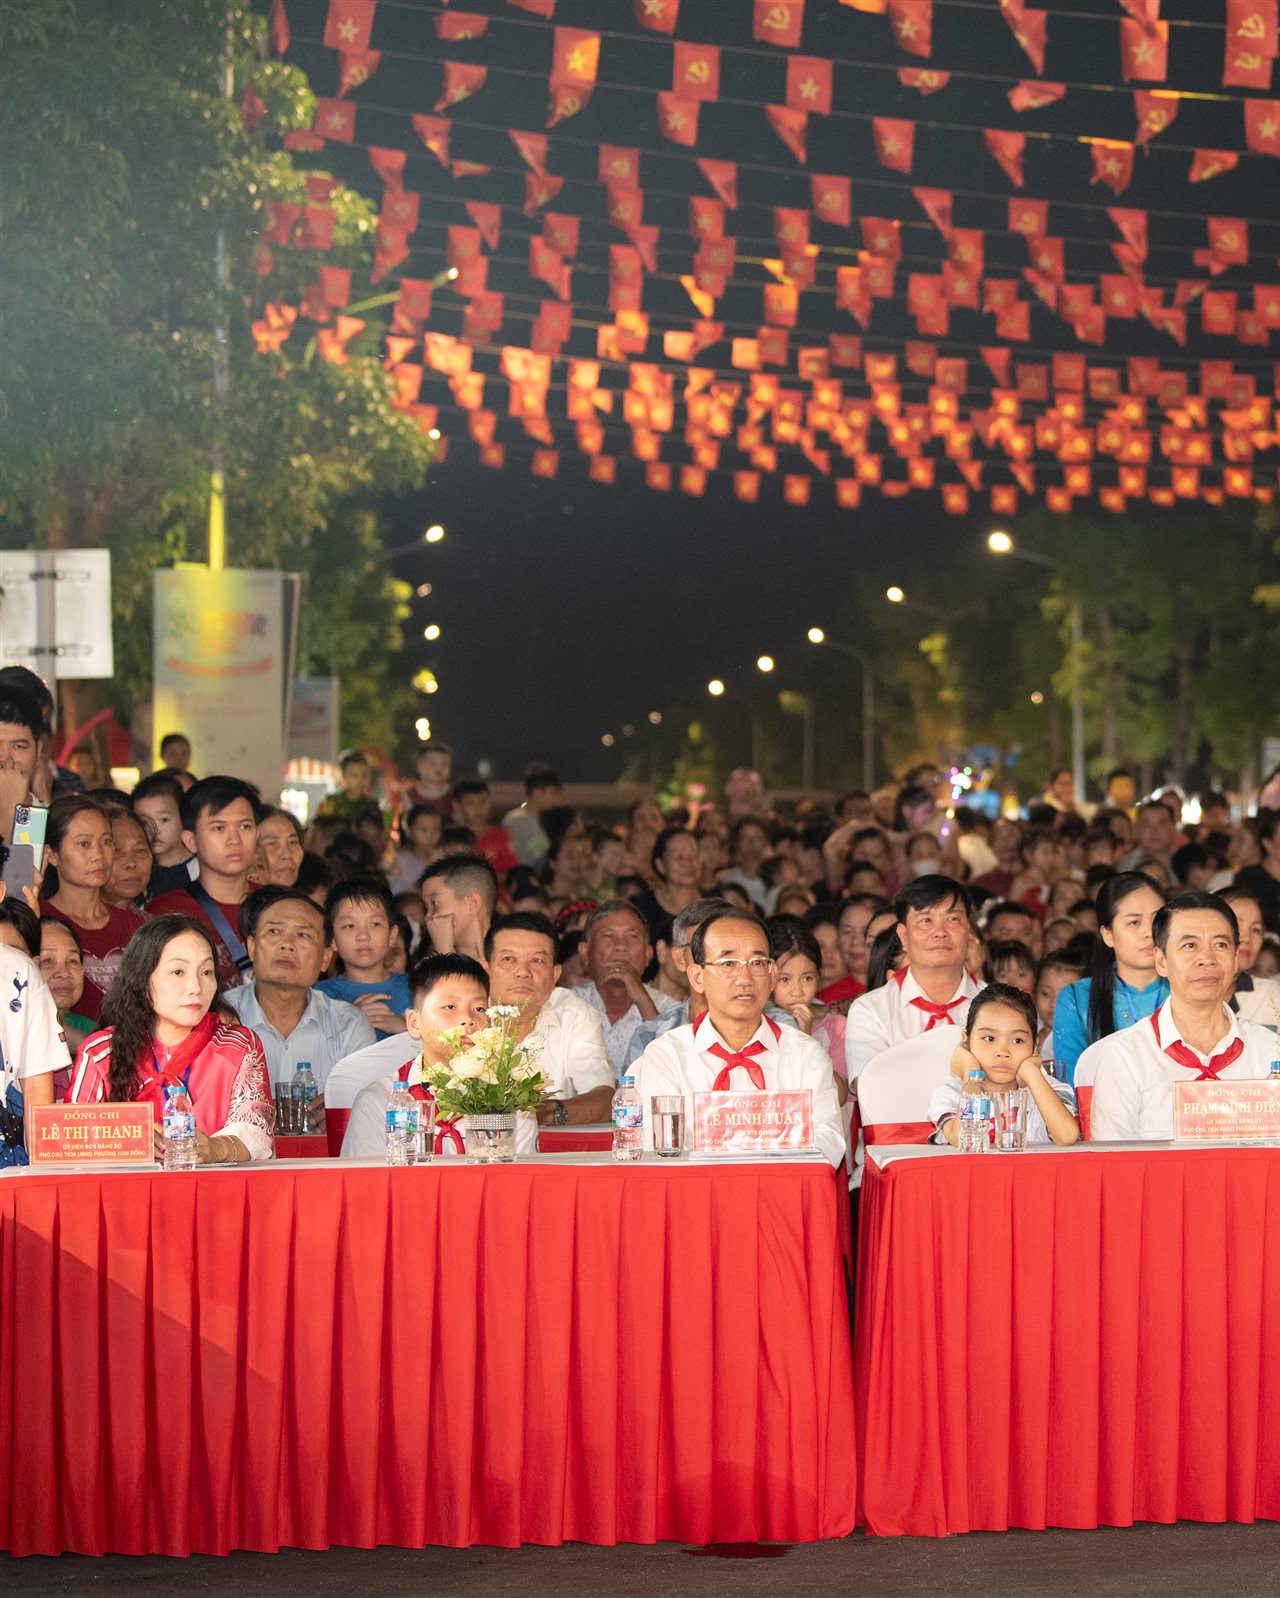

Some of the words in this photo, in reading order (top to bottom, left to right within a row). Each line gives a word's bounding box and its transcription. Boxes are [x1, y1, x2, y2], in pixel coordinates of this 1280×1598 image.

[100, 1110, 120, 1119] CHÍ
[1184, 1102, 1217, 1117] PHẠM
[704, 1110, 721, 1126] LÊ
[725, 1113, 761, 1125] MINH
[41, 1123, 60, 1140] LÊ
[64, 1126, 89, 1142] THỊ
[92, 1125, 142, 1139] THANH
